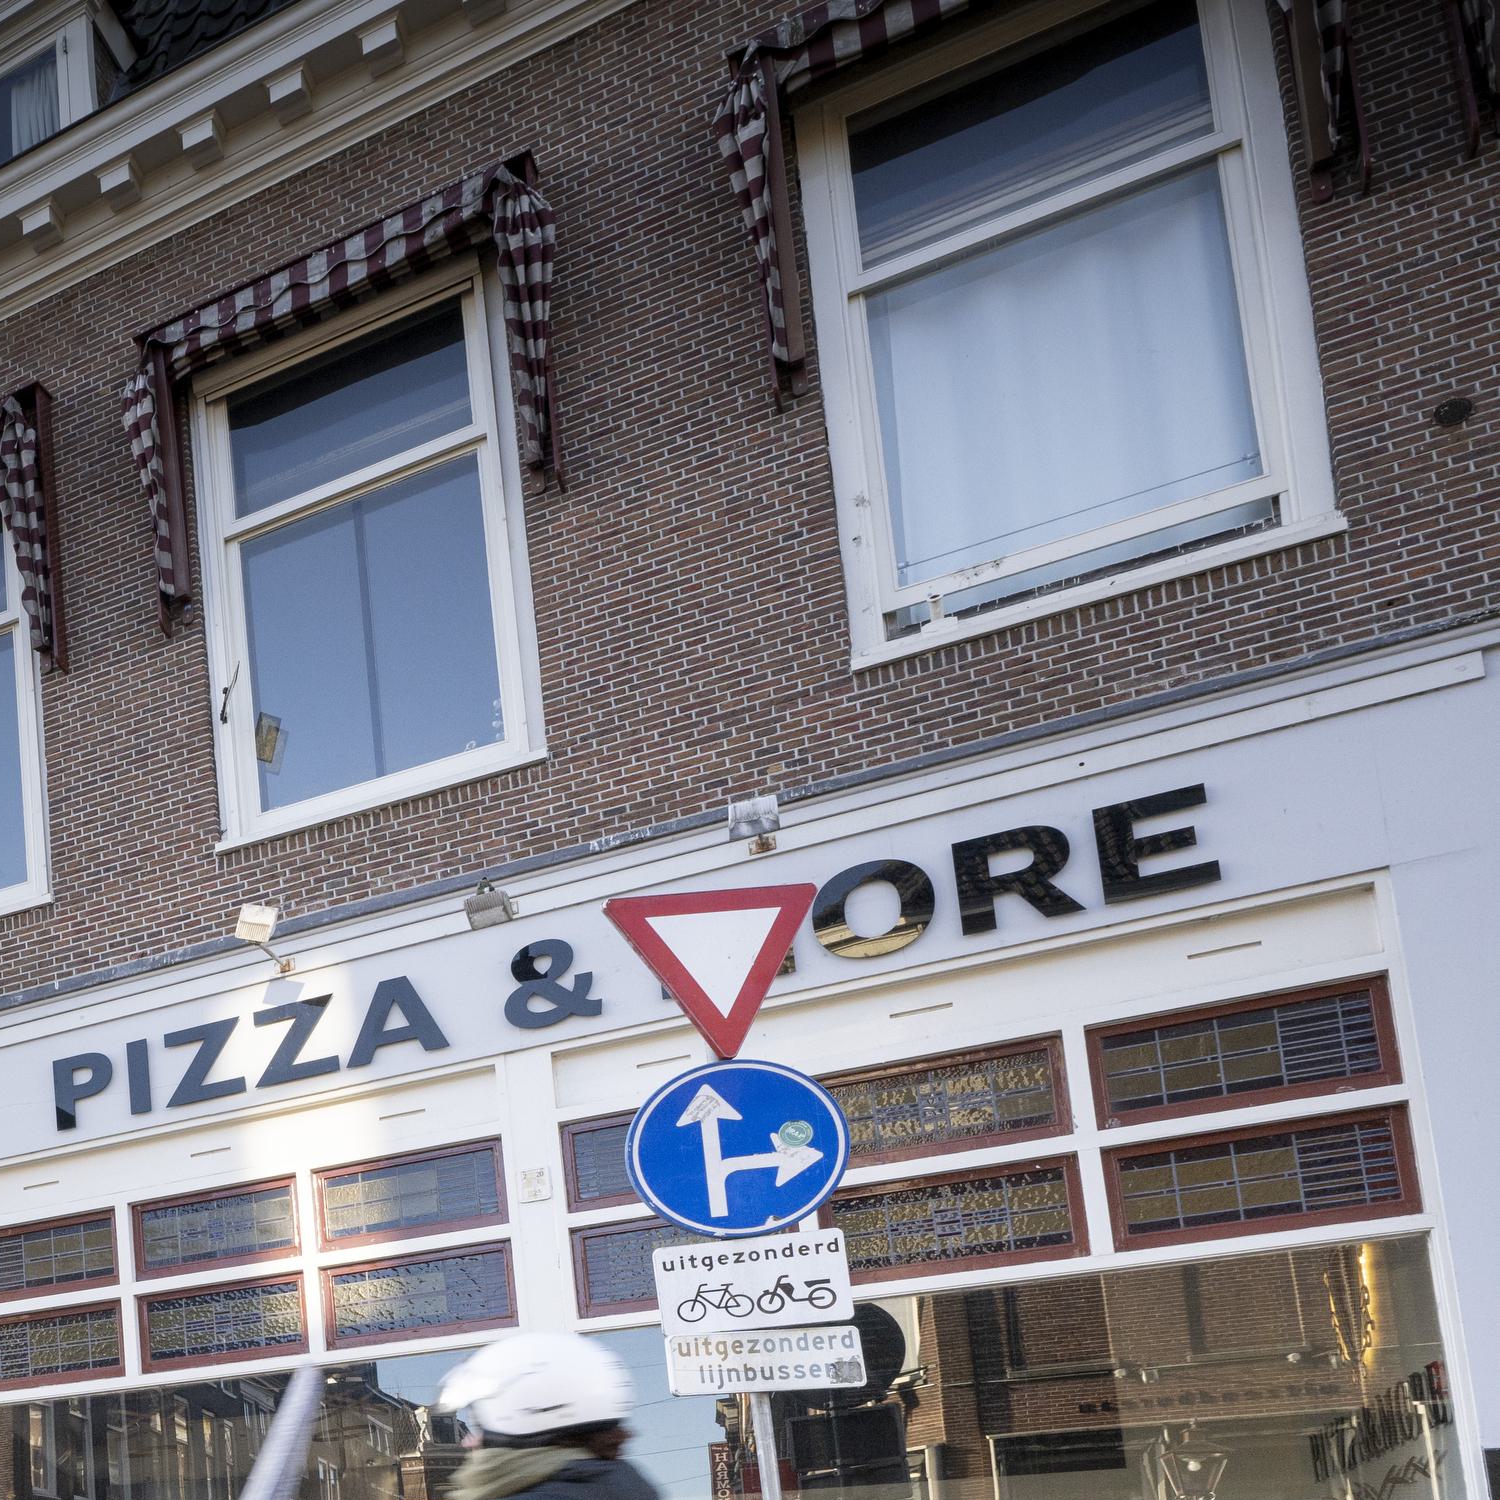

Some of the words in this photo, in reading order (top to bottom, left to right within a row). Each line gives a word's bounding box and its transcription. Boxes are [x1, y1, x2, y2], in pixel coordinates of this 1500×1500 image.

[52, 974, 451, 1132] PIZZA
[504, 938, 603, 1030] &
[661, 782, 1222, 1000] ORE
[661, 1237, 840, 1272] uitgezonderd
[676, 1330, 855, 1362] uitgezonderd
